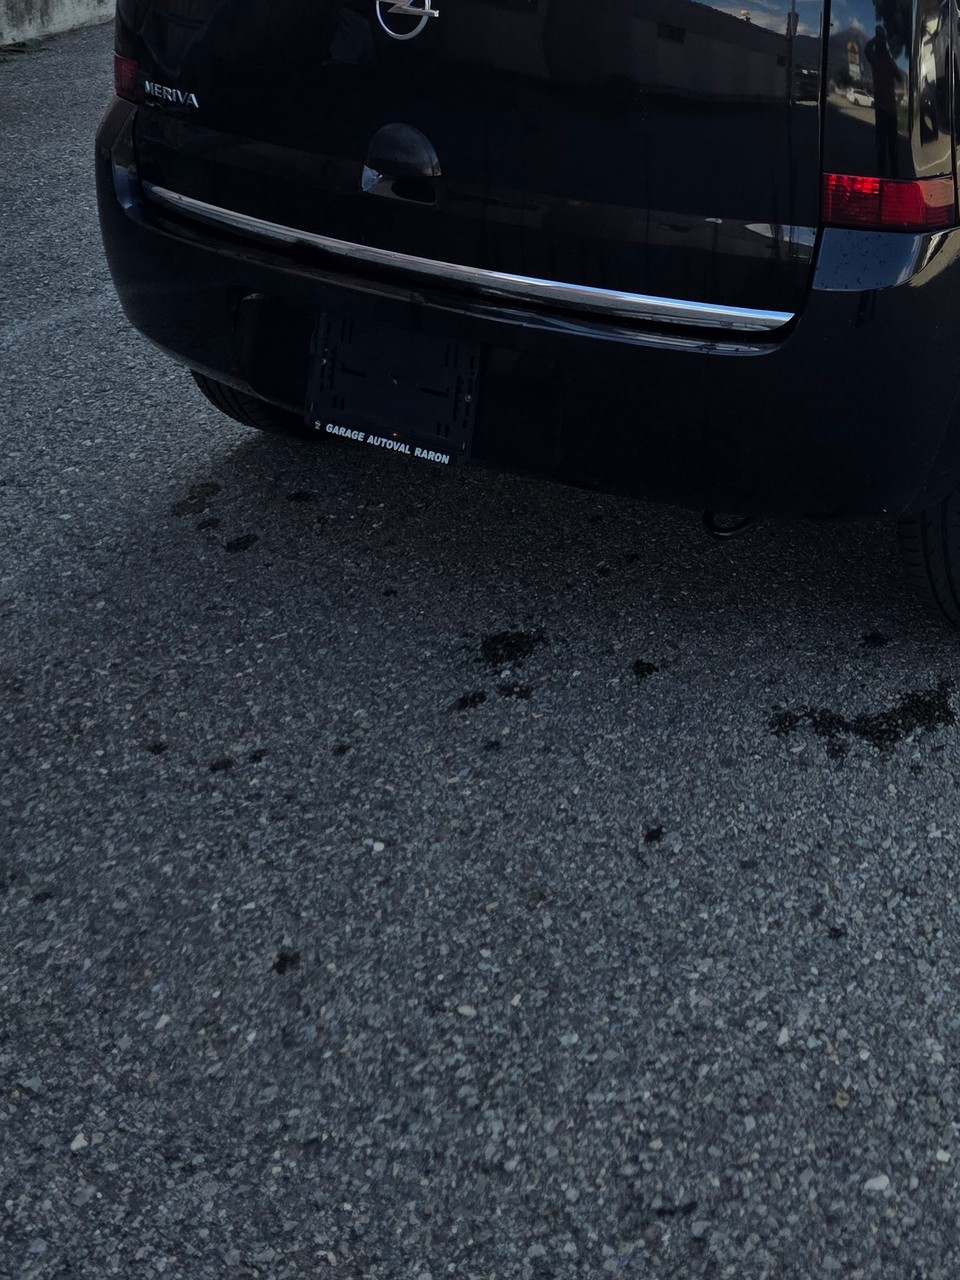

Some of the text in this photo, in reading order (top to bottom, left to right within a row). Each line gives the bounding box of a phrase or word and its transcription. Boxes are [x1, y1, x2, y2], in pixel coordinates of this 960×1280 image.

[145, 80, 199, 109] MERIVA
[325, 423, 450, 465] GARAGE AUTOVAL RARON
